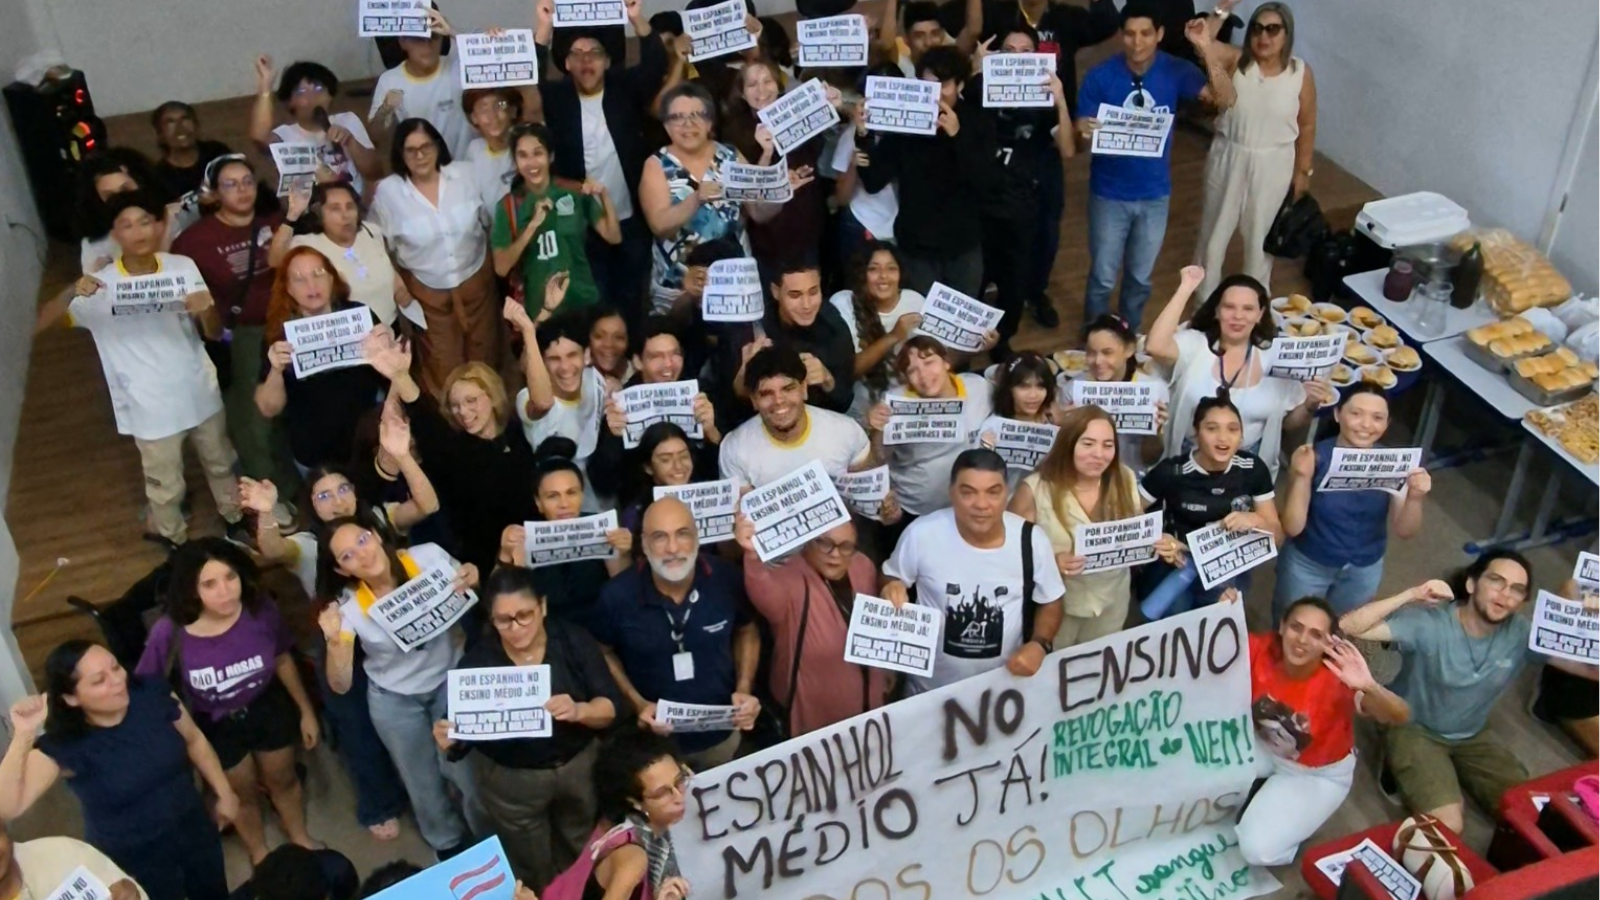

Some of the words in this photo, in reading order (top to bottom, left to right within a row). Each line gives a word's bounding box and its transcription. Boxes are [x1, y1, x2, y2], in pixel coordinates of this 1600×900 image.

[537, 229, 559, 260] 10
[294, 323, 310, 334] POR
[310, 315, 350, 330] ESPANHOL
[351, 312, 362, 323] NO
[1082, 386, 1096, 395] POR
[1098, 386, 1136, 396] ESPANHOL
[1138, 386, 1149, 396] NO
[1110, 396, 1134, 406] MÉDIO
[1342, 454, 1358, 462] POR
[1360, 454, 1396, 463] ESPANHOL
[1399, 454, 1412, 463] NO
[746, 494, 764, 510] POR
[763, 474, 804, 501] ESPANHOL
[803, 468, 817, 482] NO
[750, 501, 781, 522] ENSINO
[780, 487, 809, 507] MÉDIO
[807, 480, 823, 495] JÁ!
[535, 526, 550, 534] POR
[1084, 526, 1099, 536] POR
[1102, 520, 1140, 534] ESPANHOL
[1142, 518, 1152, 528] NO
[1196, 530, 1210, 543] POR
[1200, 538, 1224, 554] ENSINO
[378, 599, 395, 614] POR
[393, 576, 432, 605] ESPANHOL
[430, 568, 444, 582] NO
[863, 602, 879, 614] POR
[880, 605, 919, 621] ESPANHOL
[920, 612, 932, 624] NO
[1546, 599, 1562, 612] POR
[860, 615, 889, 629] ENSINO
[890, 620, 916, 634] MÉDIO
[916, 624, 930, 637] JÁ!
[1544, 611, 1574, 626] ENSINO
[1577, 617, 1600, 630] MÉDI
[459, 675, 476, 686] POR
[479, 672, 524, 685] ESPANHOL
[527, 672, 539, 682] NO
[459, 689, 490, 701] ENSINO
[494, 686, 522, 698] MÉDIO
[525, 685, 538, 696] JÁ!
[691, 712, 903, 842] ESPANHOL
[942, 688, 1024, 762] NO
[1059, 617, 1239, 713] ENSINO
[1054, 737, 1158, 778] INTEGRAL
[1183, 714, 1254, 765] NEM!
[722, 788, 918, 900] MÉDIO
[933, 727, 1050, 826] JÁ!
[967, 825, 1045, 895] OS
[1069, 791, 1240, 859] OLHOS
[72, 876, 88, 892] NO
